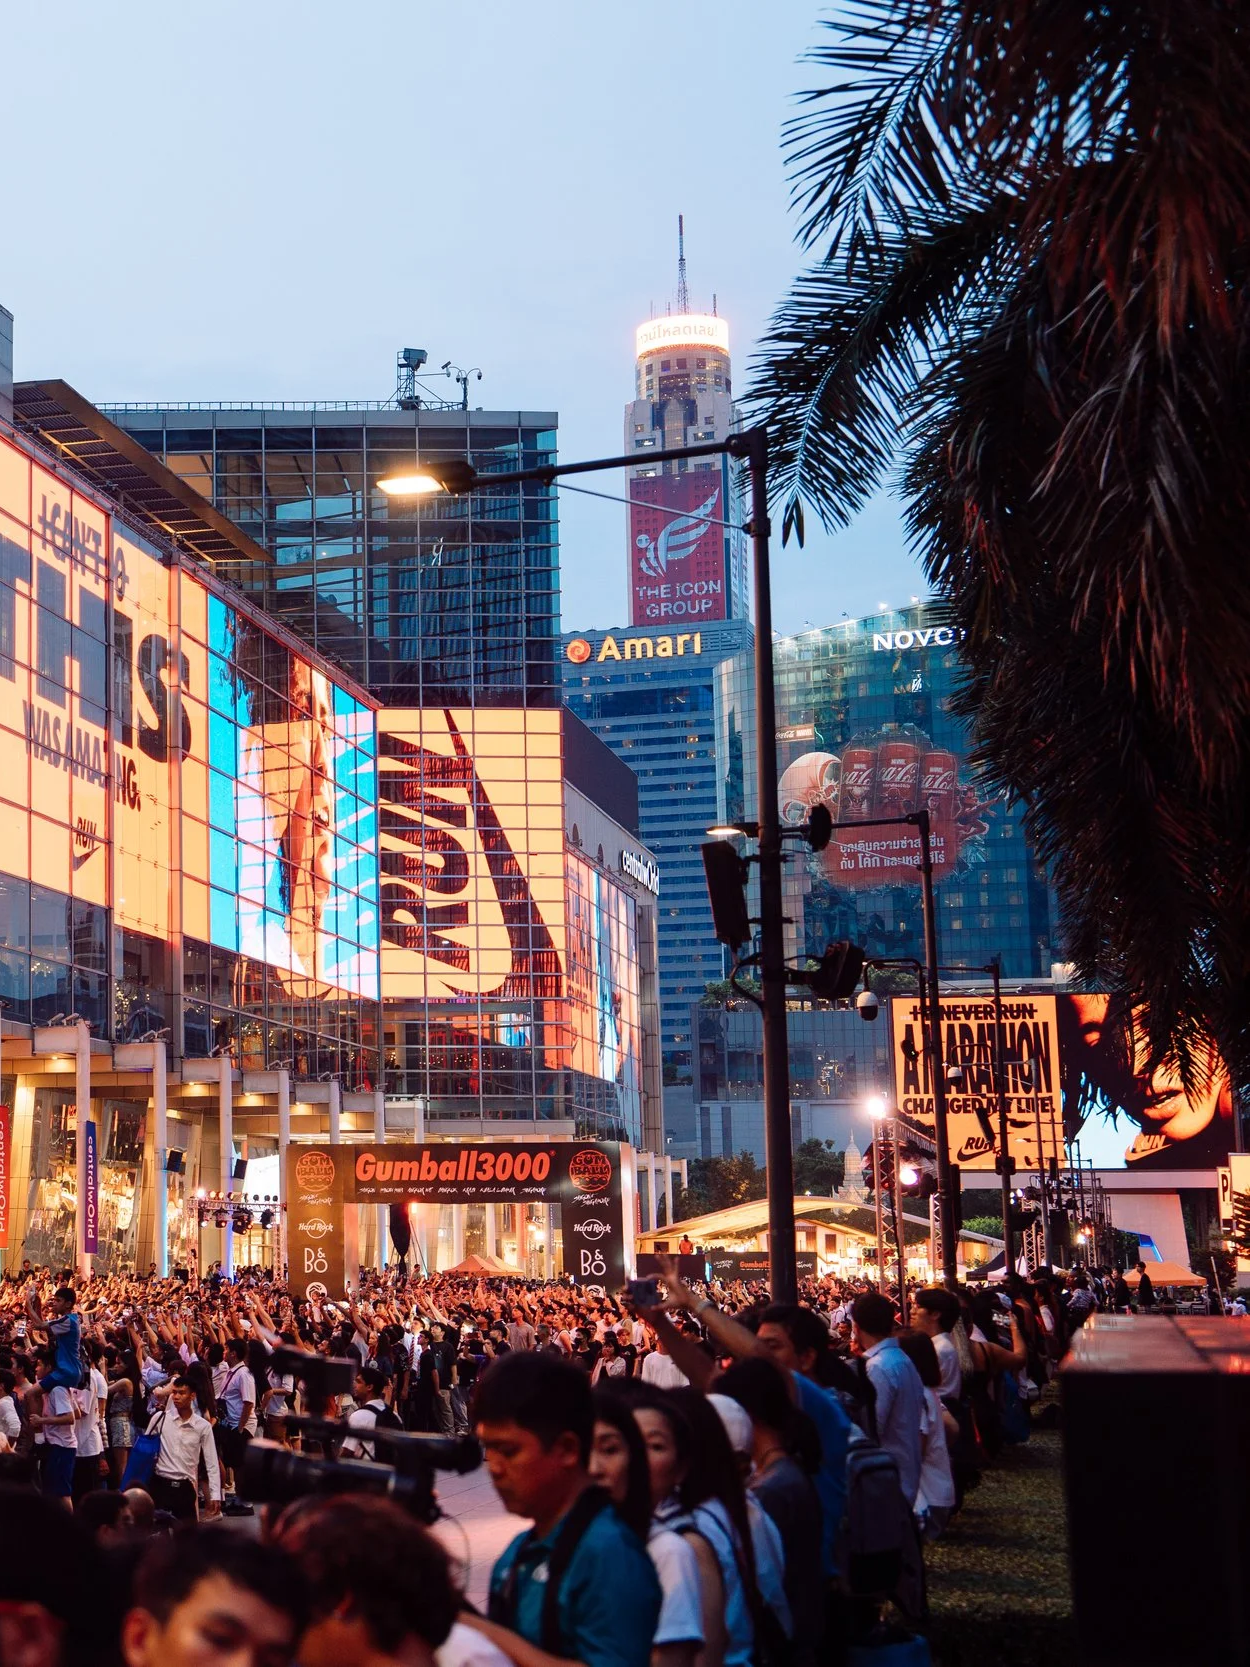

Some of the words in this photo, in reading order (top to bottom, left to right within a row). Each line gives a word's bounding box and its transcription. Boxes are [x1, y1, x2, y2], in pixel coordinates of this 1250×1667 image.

[636, 583, 671, 600] THE
[646, 599, 713, 618] GROUP
[597, 632, 703, 662] Amari
[75, 816, 97, 850] RUN
[379, 731, 470, 973] RUN
[939, 1004, 995, 1021] NEVER
[999, 1003, 1035, 1020] RUN
[903, 1024, 921, 1095] A
[1133, 1134, 1166, 1150] RUN
[356, 1150, 550, 1181] Gumball3000
[87, 1135, 95, 1239] centralwOrld
[1221, 1173, 1229, 1203] P
[299, 1222, 317, 1231] Hard
[316, 1222, 333, 1232] Rock
[573, 1223, 592, 1232] Hard
[592, 1223, 611, 1233] Rock
